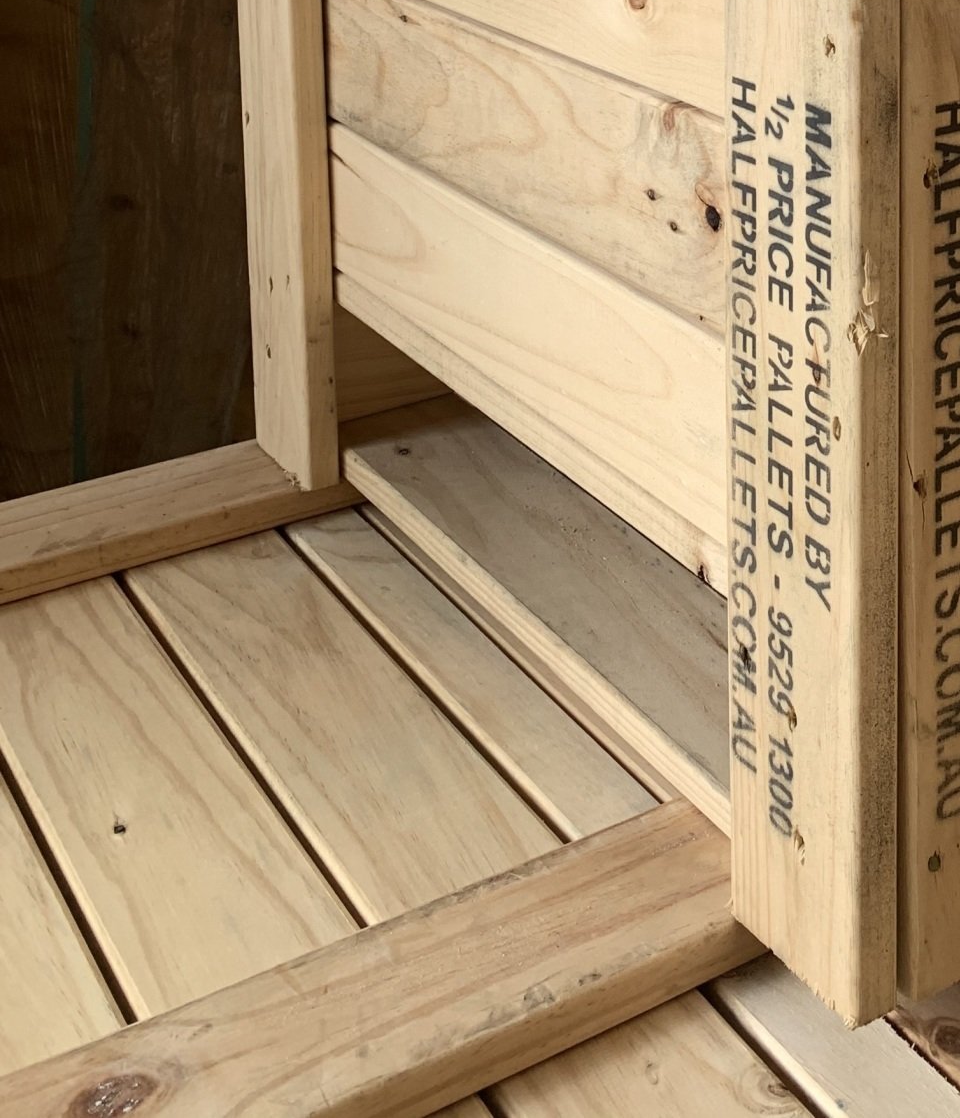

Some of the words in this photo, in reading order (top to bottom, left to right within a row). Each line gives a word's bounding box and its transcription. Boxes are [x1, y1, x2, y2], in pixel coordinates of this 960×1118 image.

[768, 156, 794, 312] PRICE
[804, 102, 831, 527] MANUFACTURED
[731, 76, 757, 774] HALFPRICEPALLETS.COM.AU
[768, 333, 794, 560] PALLETS
[804, 534, 831, 613] BY
[768, 605, 796, 721] 9529
[768, 734, 794, 838] 1300
